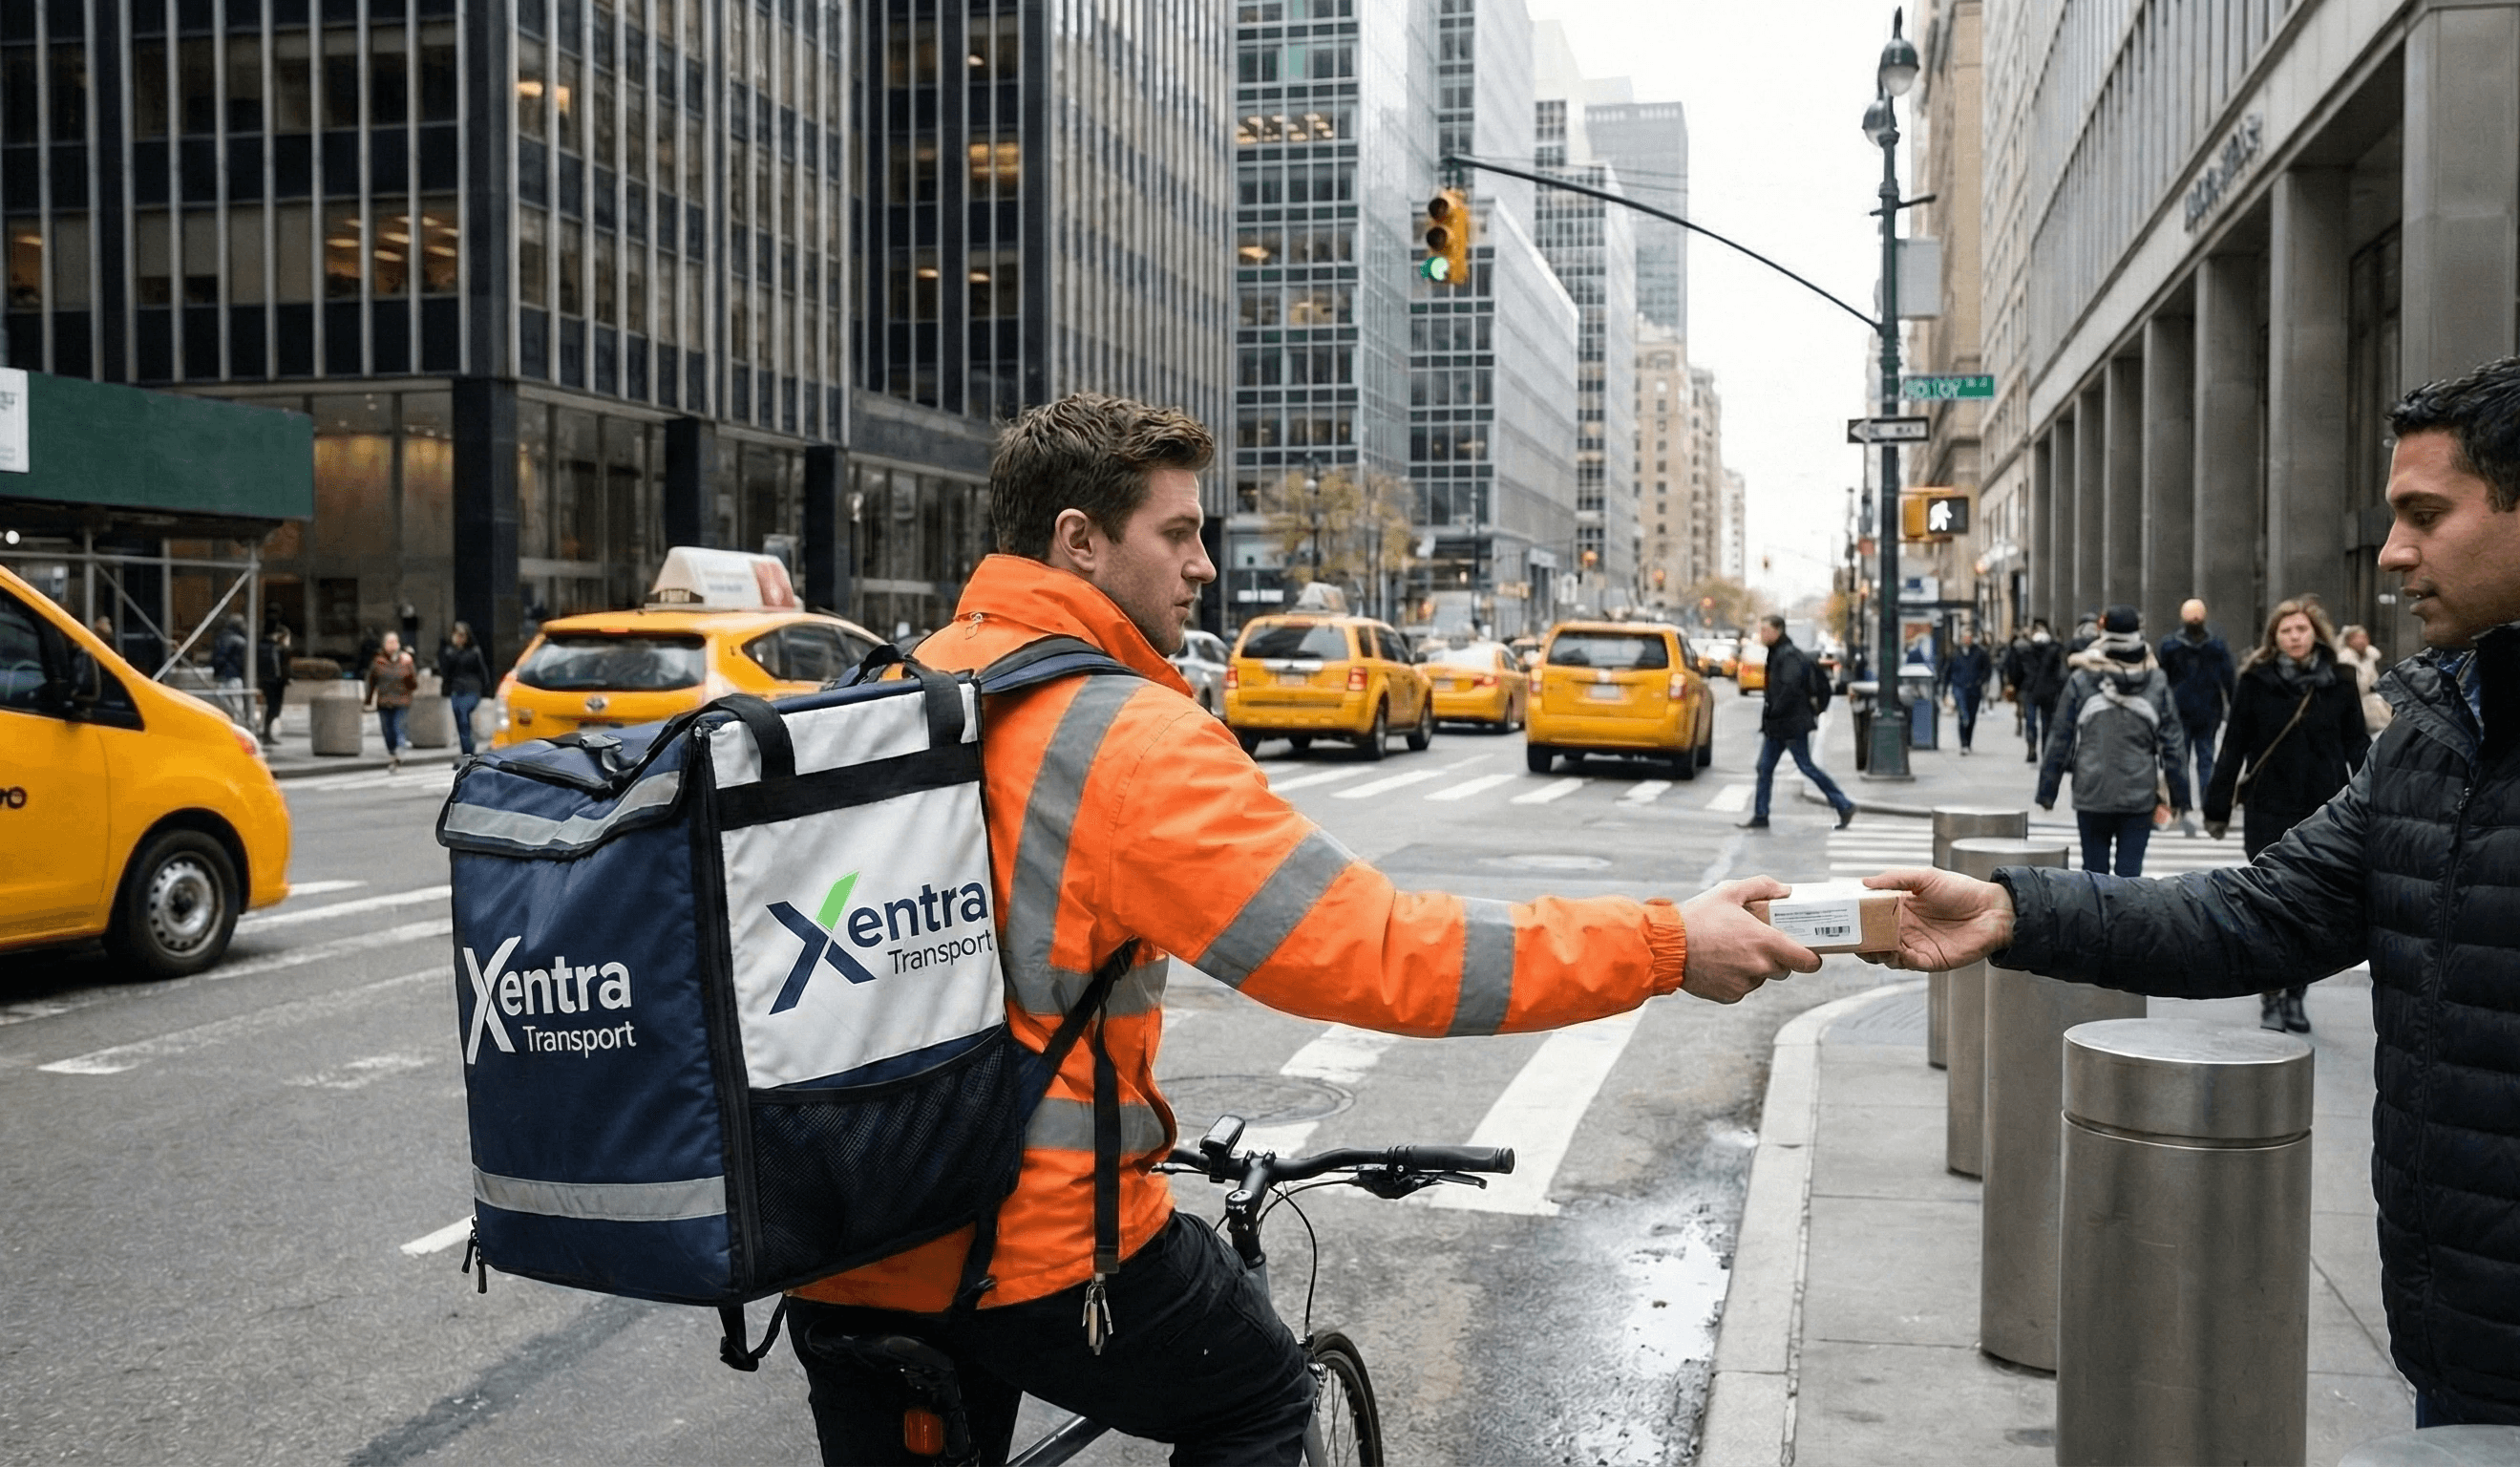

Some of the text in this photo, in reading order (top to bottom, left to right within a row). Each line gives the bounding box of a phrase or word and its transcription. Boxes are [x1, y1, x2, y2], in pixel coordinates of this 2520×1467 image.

[766, 871, 988, 1015] Xentra
[887, 929, 993, 975] Transport
[463, 935, 632, 1065] Xentra
[522, 1021, 637, 1058] Transport
